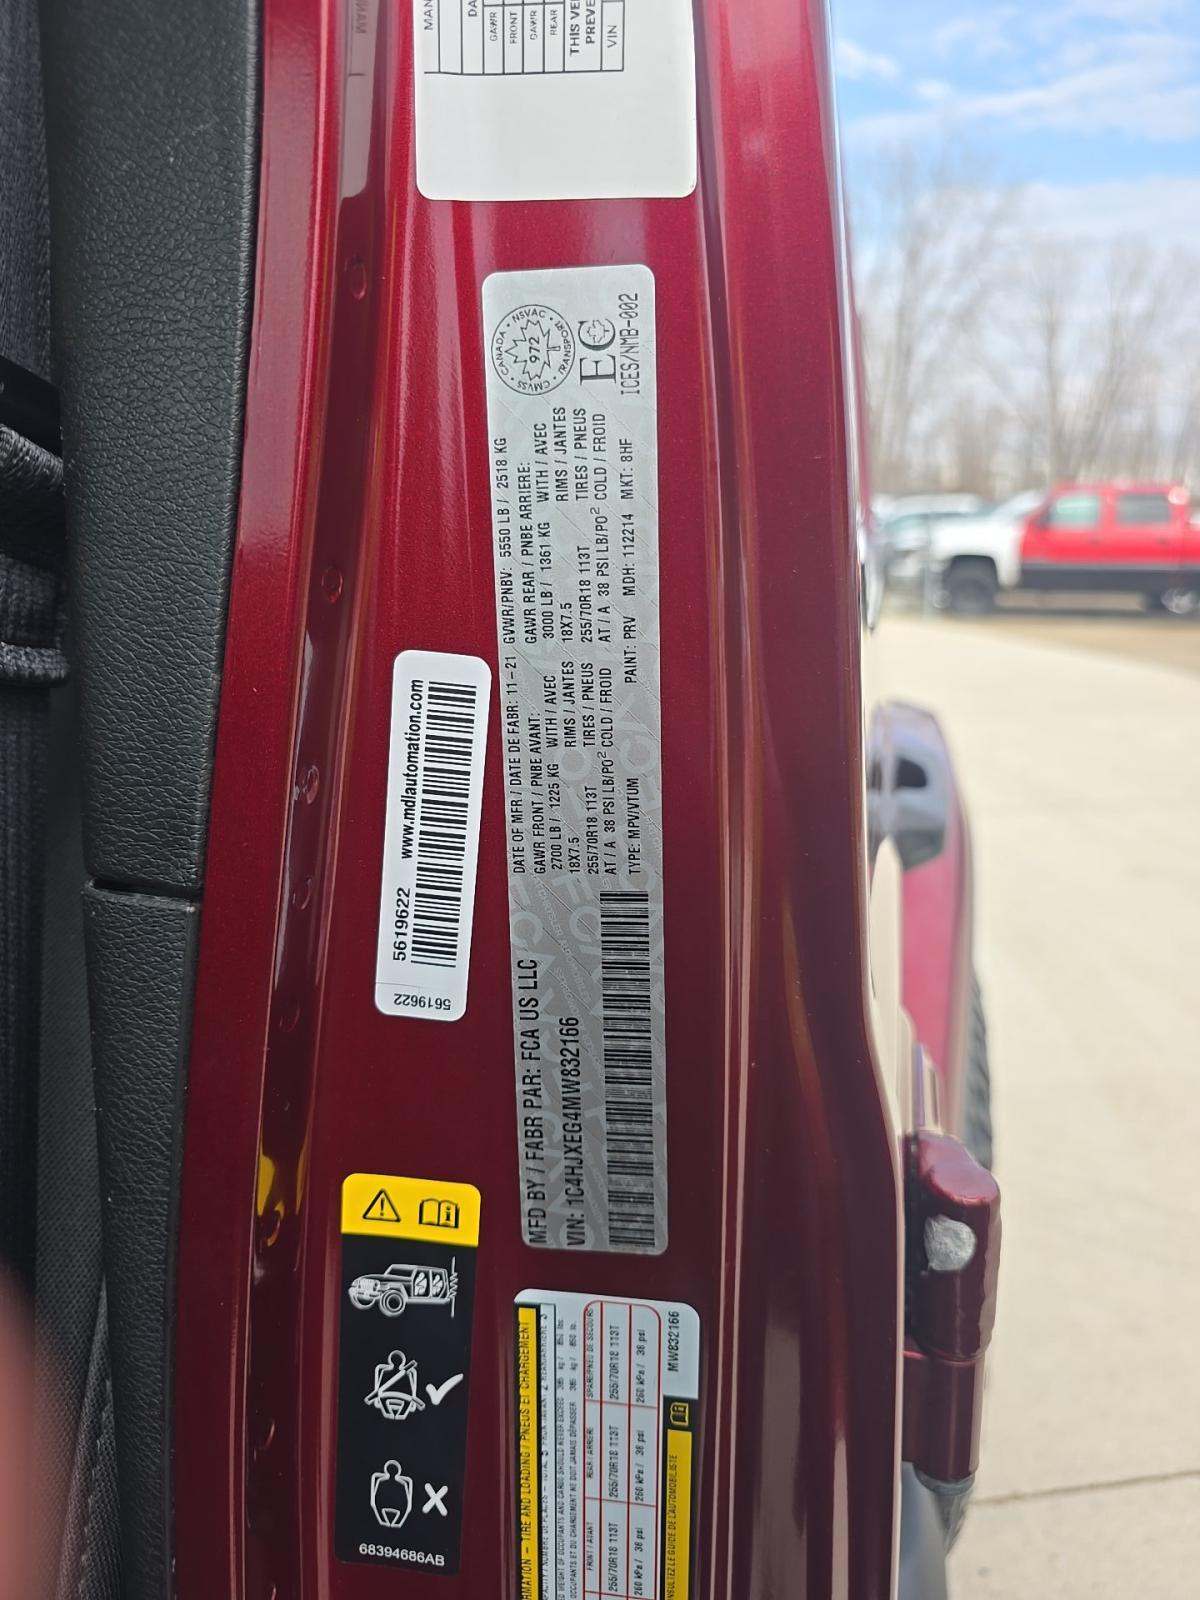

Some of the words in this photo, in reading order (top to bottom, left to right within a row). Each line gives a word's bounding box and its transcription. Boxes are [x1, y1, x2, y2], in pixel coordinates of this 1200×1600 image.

[489, 11, 498, 42] GAWR
[509, 12, 518, 44] FRONT
[529, 10, 538, 40] GAWR
[550, 9, 558, 36] REAR
[607, 25, 618, 48] VIN
[569, 23, 580, 56] THIS
[511, 307, 546, 323] NSVAC
[495, 331, 509, 376] CANADA
[528, 336, 540, 363] 972
[554, 320, 571, 375] TRANSPORT
[618, 293, 640, 395] ICES/NMB-002
[517, 380, 551, 391] CMVSS
[533, 423, 548, 456] AVEC
[552, 407, 567, 455] JANTES
[573, 408, 587, 450] PNEUS
[592, 413, 606, 452] FROID
[493, 437, 507, 454] KG
[619, 438, 633, 462] 8HF
[495, 459, 509, 489] 2518
[535, 470, 550, 503] WITH
[554, 469, 569, 502] RIMS
[574, 465, 589, 501] TIRES
[593, 467, 607, 500] COLD
[619, 468, 634, 500] MKT:
[517, 462, 532, 520] ARRIERE:
[497, 508, 510, 523] LB
[537, 522, 550, 537] KG
[498, 528, 512, 557] 5550
[519, 525, 534, 556] PNBE
[621, 513, 635, 558] 112214
[539, 544, 552, 572] 1361
[577, 545, 591, 574] 113T
[596, 557, 610, 577] PSI
[522, 571, 536, 603] REAR
[597, 582, 610, 597] 38
[622, 563, 636, 596] MDH:
[500, 567, 516, 644] GVWR/PNBV:
[540, 591, 553, 606] LB
[578, 579, 593, 643] 255/70R18
[597, 606, 610, 614] A
[523, 608, 537, 644] GAWR
[541, 611, 555, 639] 3000
[560, 602, 573, 643] 18X7.5
[598, 628, 611, 643] AT
[623, 616, 636, 639] PRV
[623, 645, 637, 683] PAINT:
[543, 675, 557, 705] AVEC
[561, 661, 576, 705] JANTES
[580, 662, 595, 701] PNEUS
[599, 668, 612, 703] FROID
[506, 701, 520, 734] FABR:
[544, 718, 558, 748] WITH
[563, 718, 577, 748] RIMS
[582, 714, 596, 748] TIRES
[600, 717, 614, 747] COLD
[507, 738, 521, 753] DE
[528, 713, 542, 754] AVANT:
[400, 679, 424, 859] www.mdlautomation.com
[508, 758, 522, 786] DATE
[529, 758, 543, 787] PNBE
[546, 763, 560, 778] KG
[510, 799, 524, 824] MFR
[548, 783, 561, 809] 1225
[584, 786, 597, 812] 113T
[602, 797, 615, 815] PSI
[626, 778, 640, 839] MPV/VTUM
[531, 800, 545, 837] FRONT
[549, 826, 562, 840] LB
[603, 819, 616, 833] 38
[511, 828, 524, 842] OF
[586, 817, 599, 875] 255/70R18
[604, 841, 616, 849] A
[512, 846, 526, 874] DATE
[533, 841, 546, 874] GAWR
[550, 844, 563, 870] 2700
[567, 837, 581, 874] 18X7.5
[604, 861, 617, 875] AT
[628, 844, 641, 875] TYPE:
[393, 887, 410, 961] 5619622
[517, 959, 538, 990] LLC
[394, 993, 451, 1011] 5619622
[518, 997, 539, 1021] US
[520, 1028, 541, 1061] FCA
[522, 1069, 542, 1109] PAR:
[559, 1017, 585, 1206] 1C4HJXEG4MW832166
[523, 1116, 544, 1161] FABR
[526, 1179, 546, 1201] BY
[527, 1208, 547, 1243] MFD
[566, 1213, 586, 1246] VIN:
[667, 1311, 680, 1372] MW832166
[608, 1522, 618, 1542] 113T
[358, 1543, 445, 1567] 68394686AB
